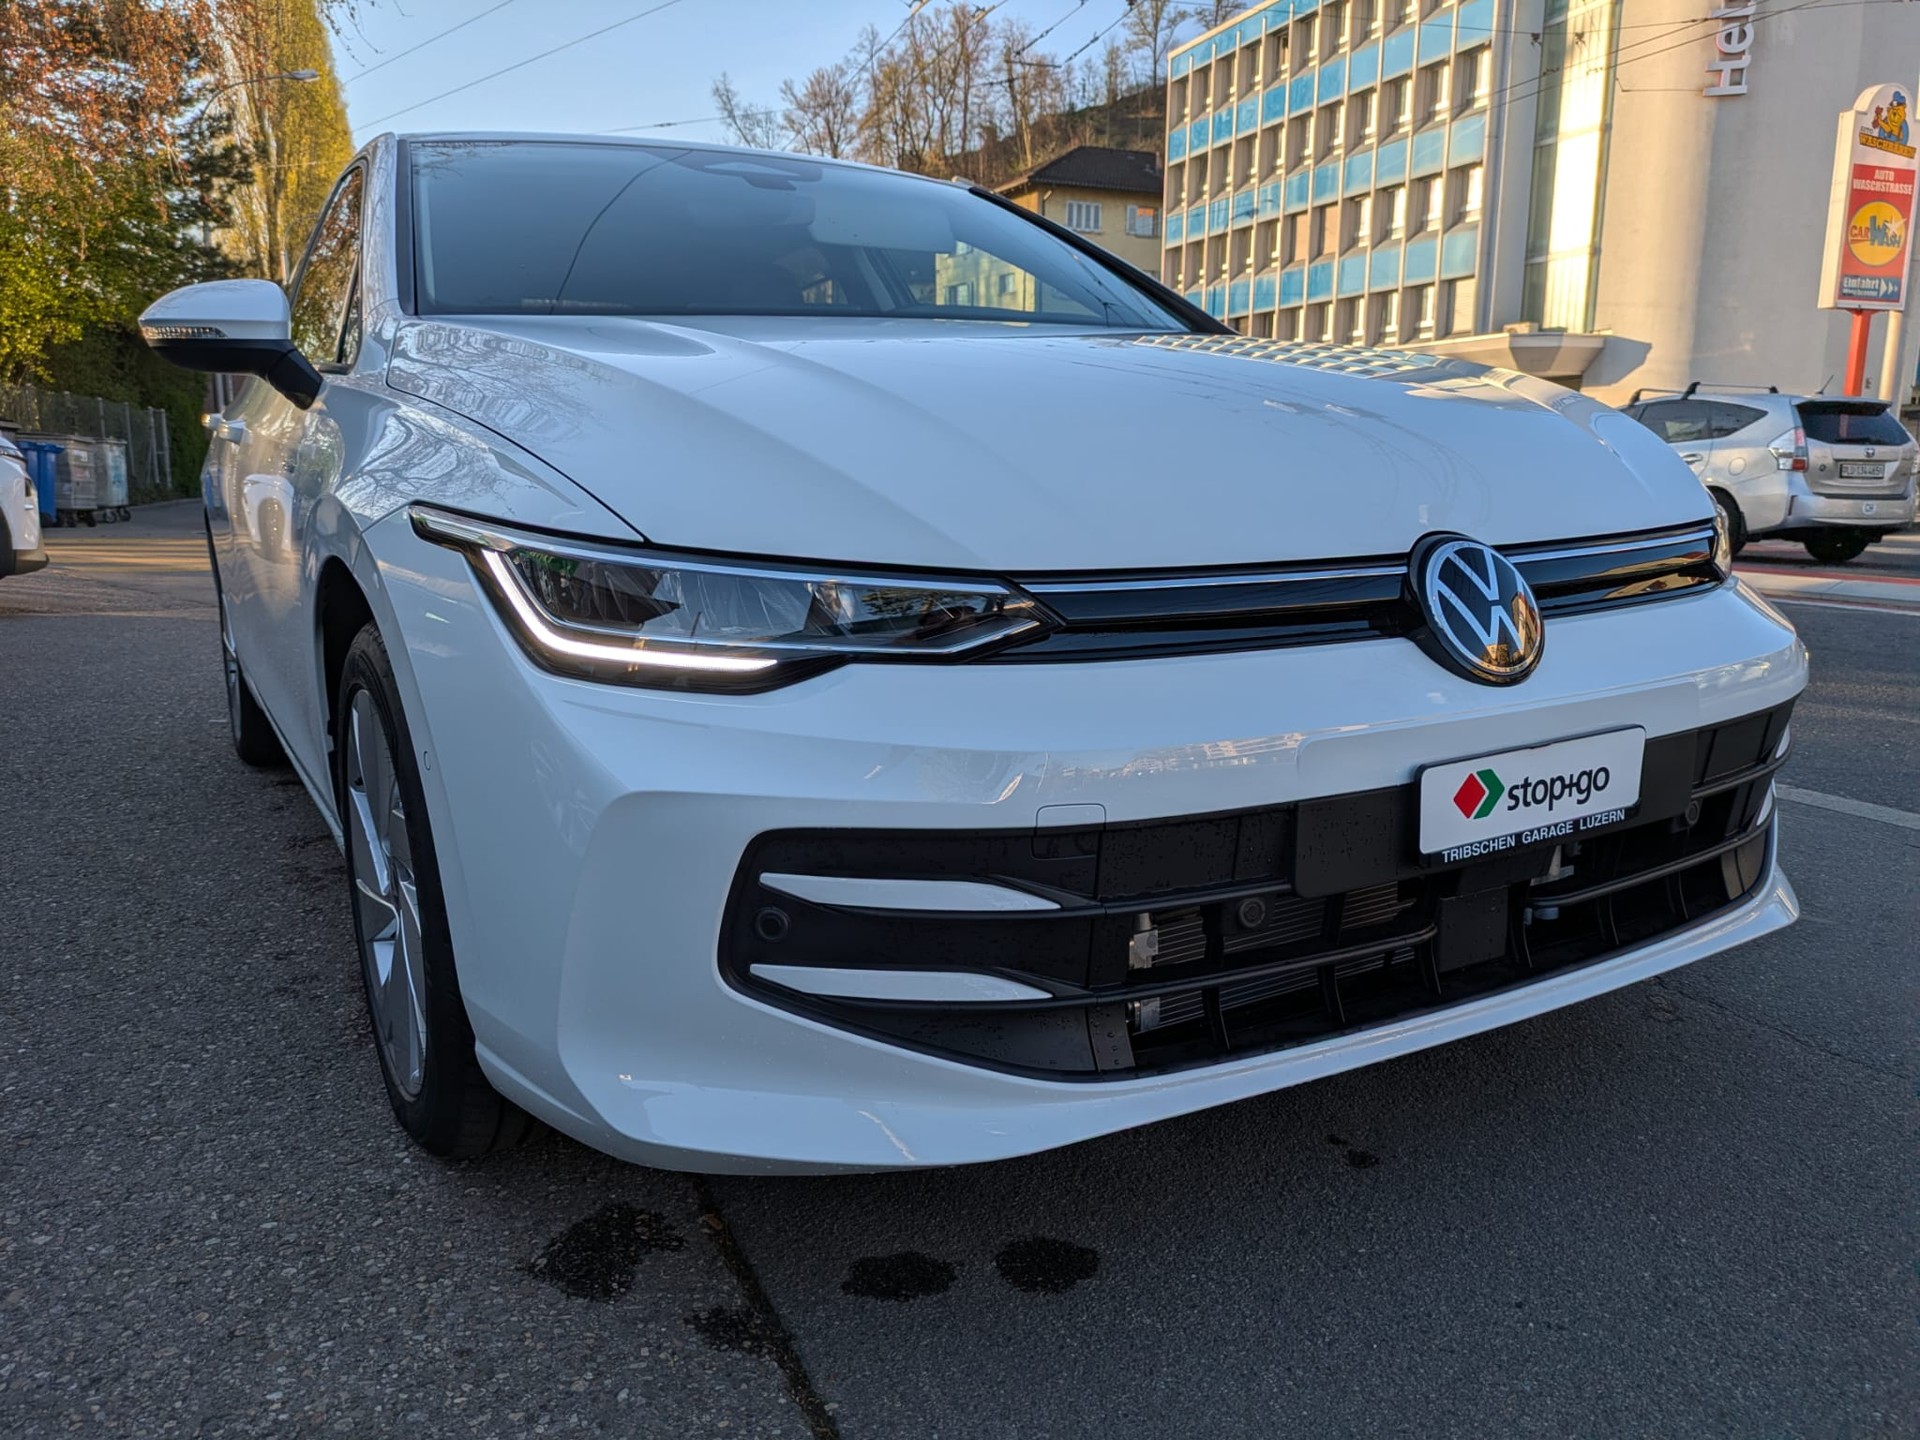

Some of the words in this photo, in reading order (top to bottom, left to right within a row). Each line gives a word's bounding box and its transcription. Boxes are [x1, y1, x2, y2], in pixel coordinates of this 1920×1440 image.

[1874, 169, 1894, 181] AUTO
[1853, 178, 1913, 195] WASCHSTRASSE
[1850, 225, 1869, 239] CAR
[1843, 276, 1879, 289] Einfahrt
[1507, 766, 1610, 811] stop+go
[1442, 835, 1516, 863] TRIBSCHEN
[1522, 820, 1573, 844] GARAGE
[1580, 808, 1625, 831] LUZERN
